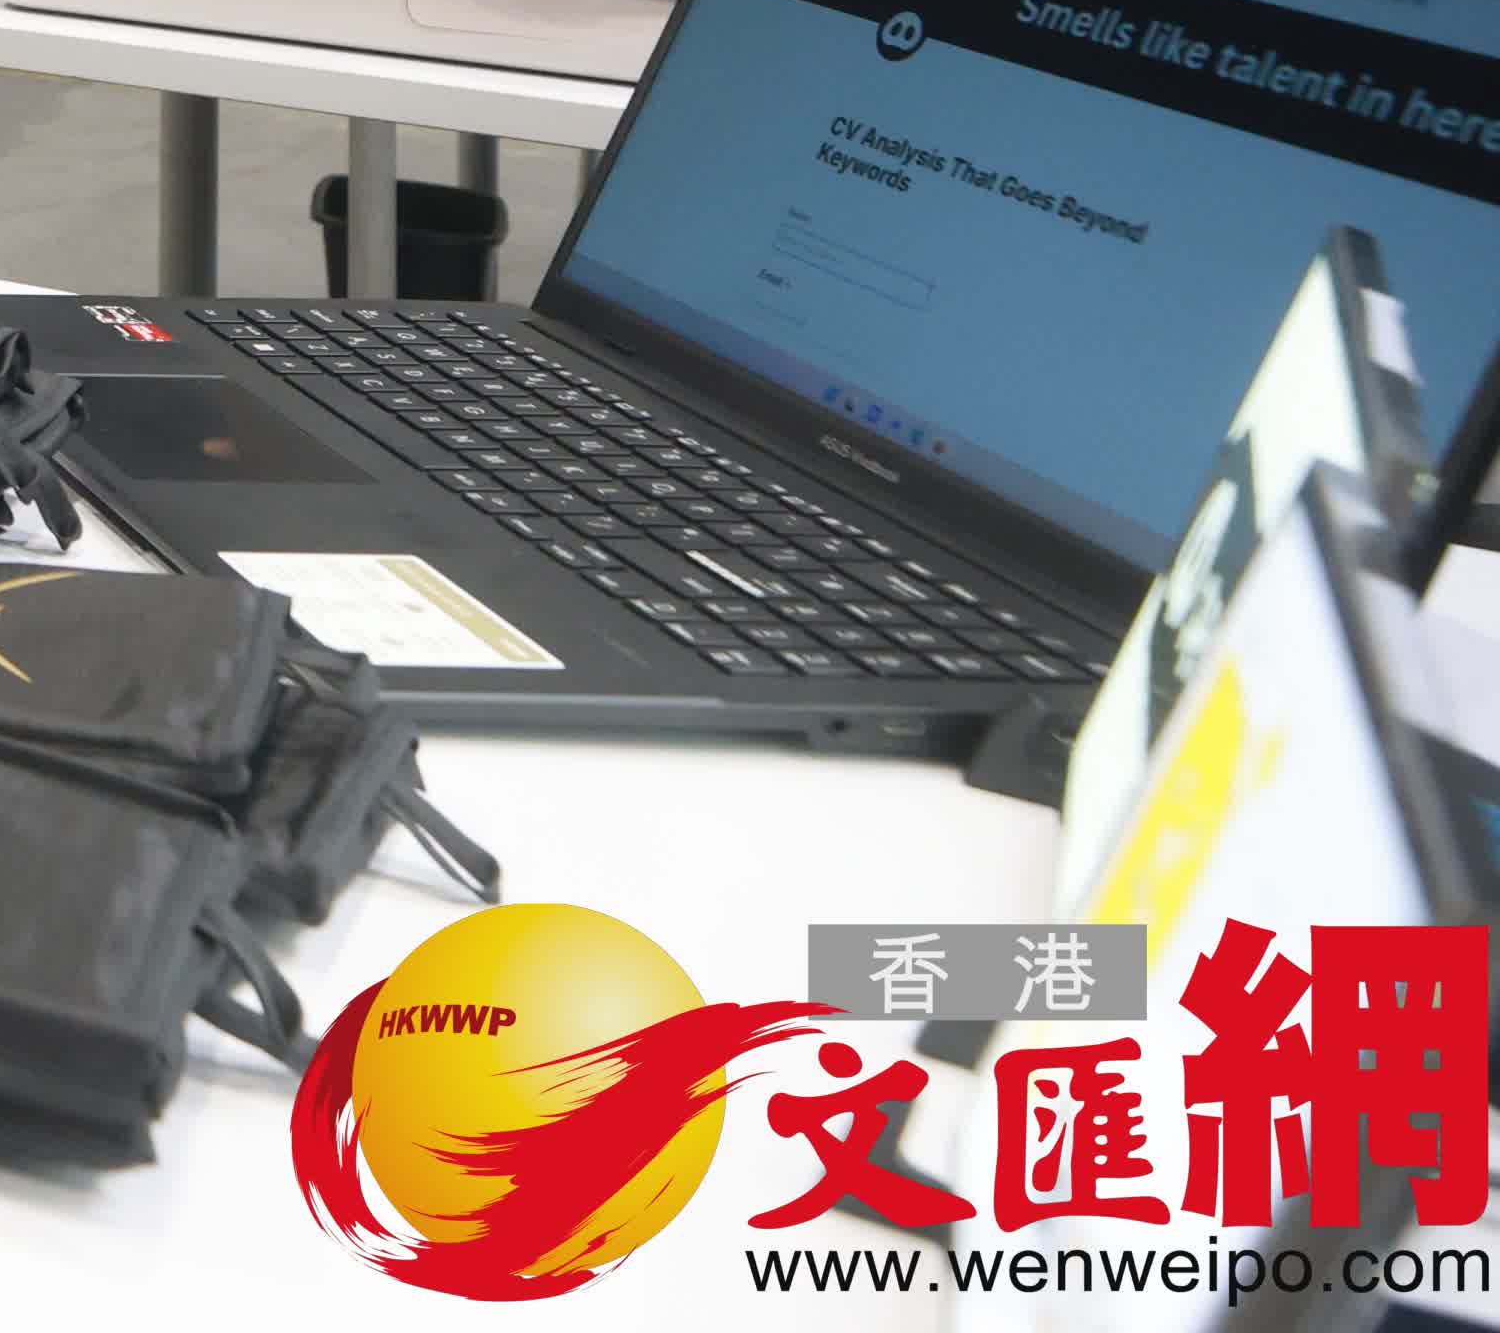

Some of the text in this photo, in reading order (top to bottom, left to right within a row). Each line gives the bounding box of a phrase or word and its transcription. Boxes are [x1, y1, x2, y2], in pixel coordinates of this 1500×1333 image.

[1139, 19, 1211, 71] like
[1214, 43, 1348, 110] talent
[1345, 73, 1396, 122] in
[815, 140, 912, 193] Keywords
[829, 115, 1150, 245] CV Analysis That Goes Beyond
